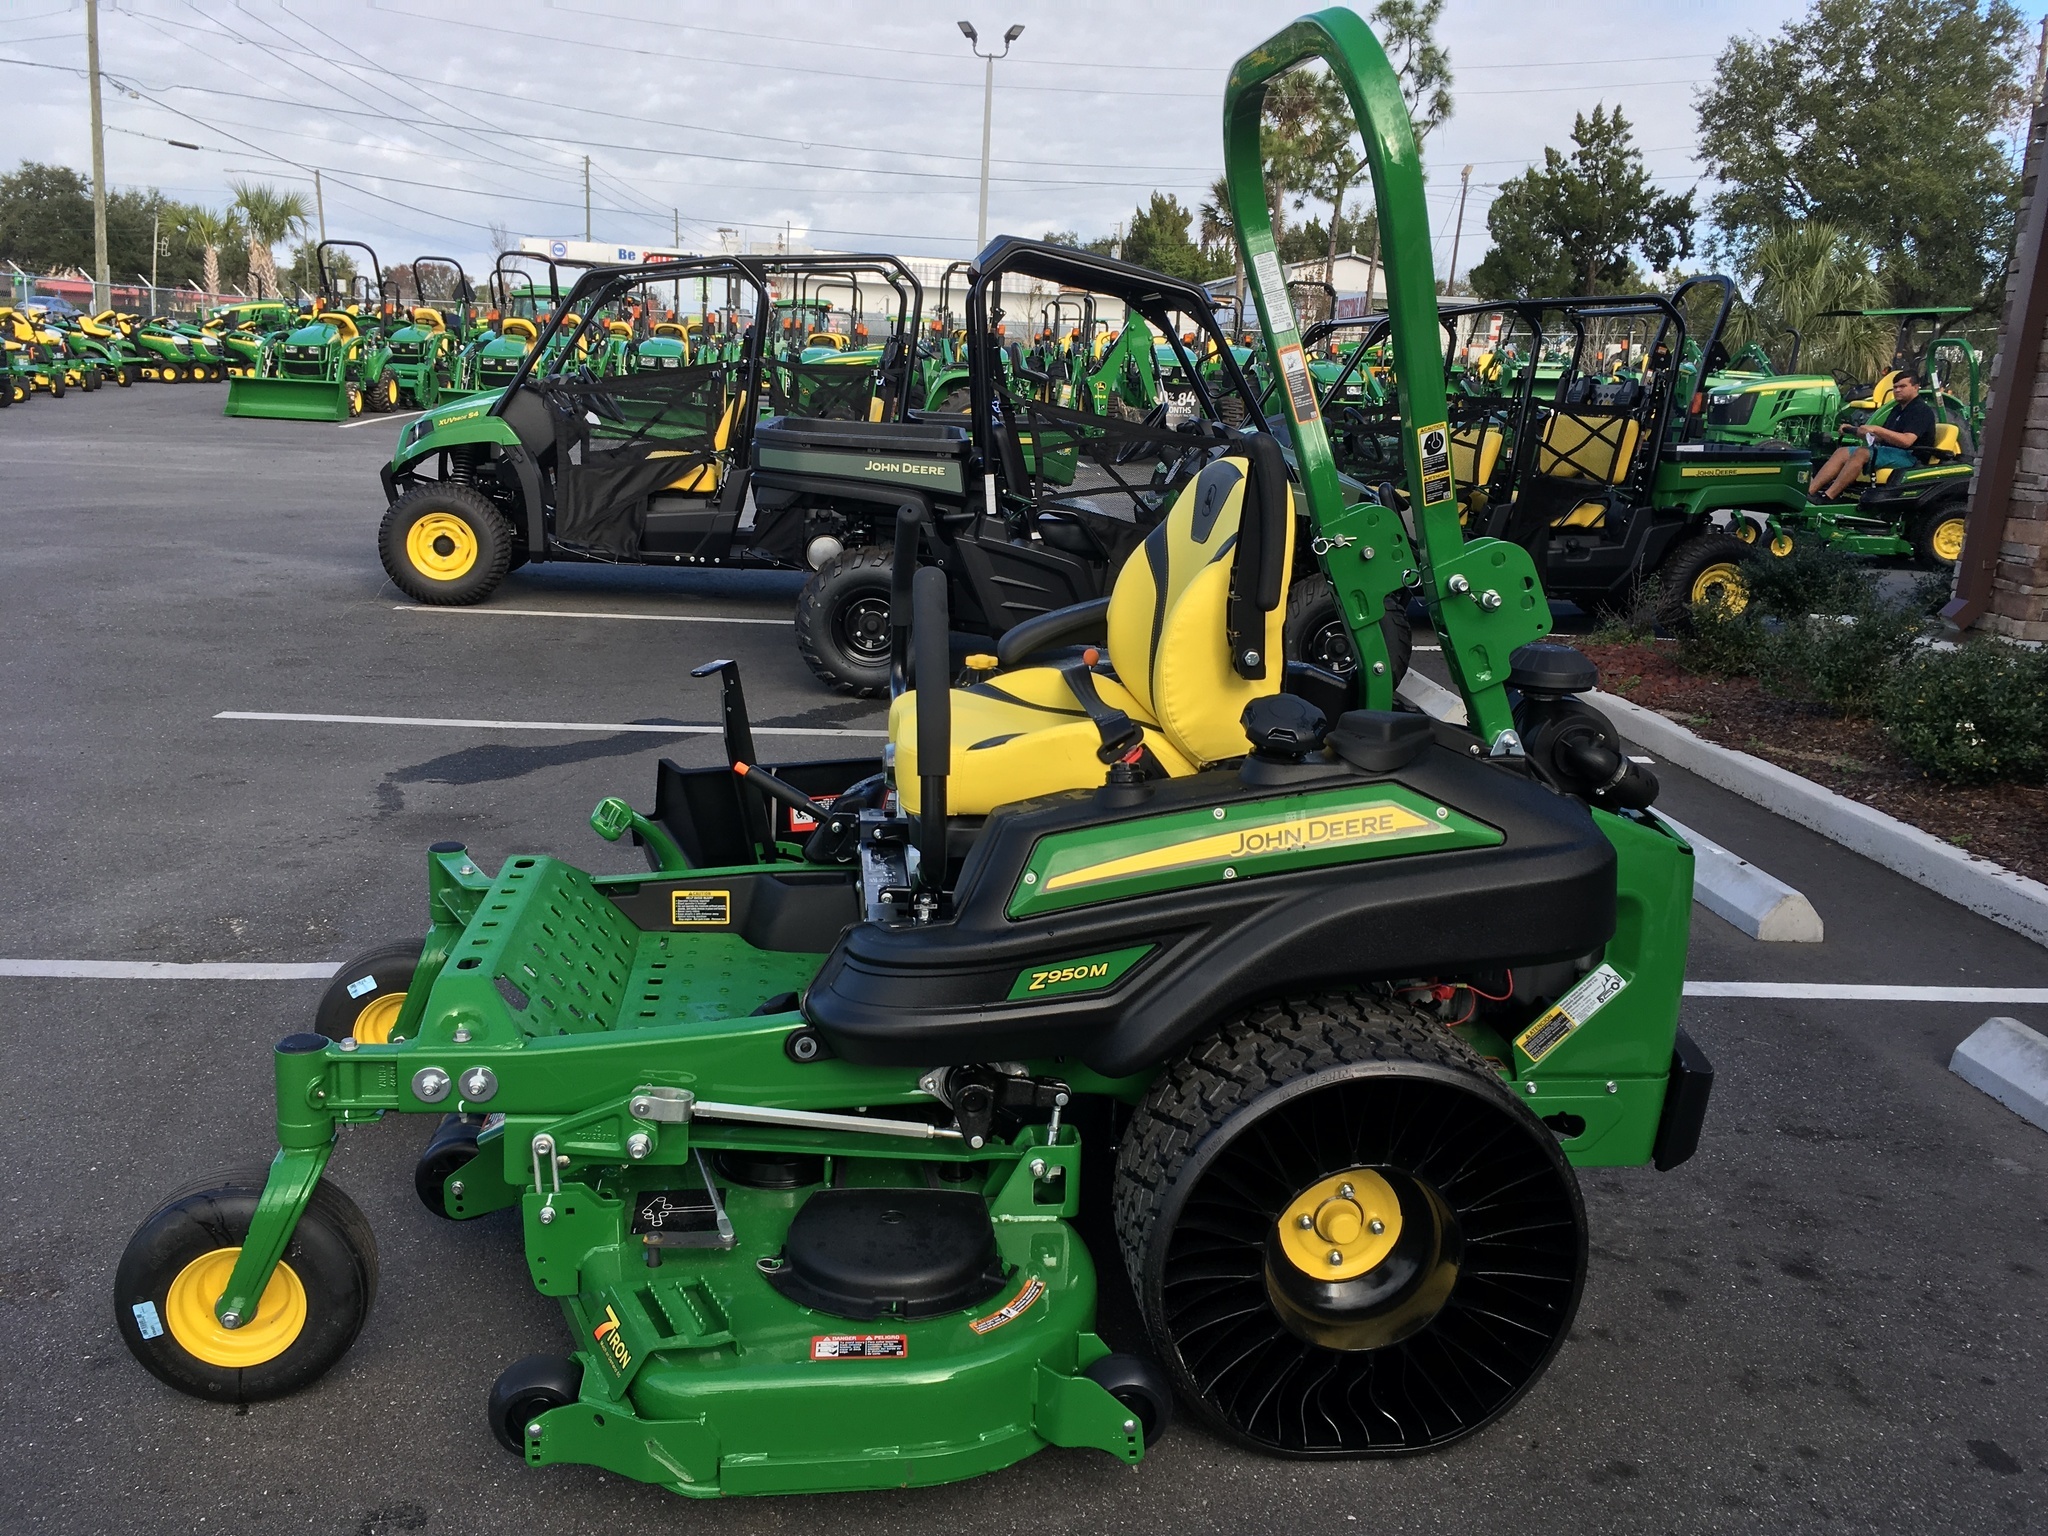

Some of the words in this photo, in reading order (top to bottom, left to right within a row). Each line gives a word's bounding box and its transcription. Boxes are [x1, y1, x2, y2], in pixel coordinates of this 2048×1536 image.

[618, 248, 636, 261] Be
[1178, 391, 1196, 406] 84
[1169, 406, 1191, 414] ONTHS
[864, 460, 900, 472] JOHN
[902, 463, 946, 476] DEERE
[1695, 469, 1715, 477] JOHN
[1715, 468, 1738, 476] DEERE
[1231, 827, 1301, 855] JOHN
[1308, 813, 1394, 841] DEERE
[1028, 962, 1109, 991] Z950M
[1278, 1068, 1354, 1101] MICHELIN
[593, 1303, 621, 1341] 7
[606, 1327, 632, 1370] IRON
